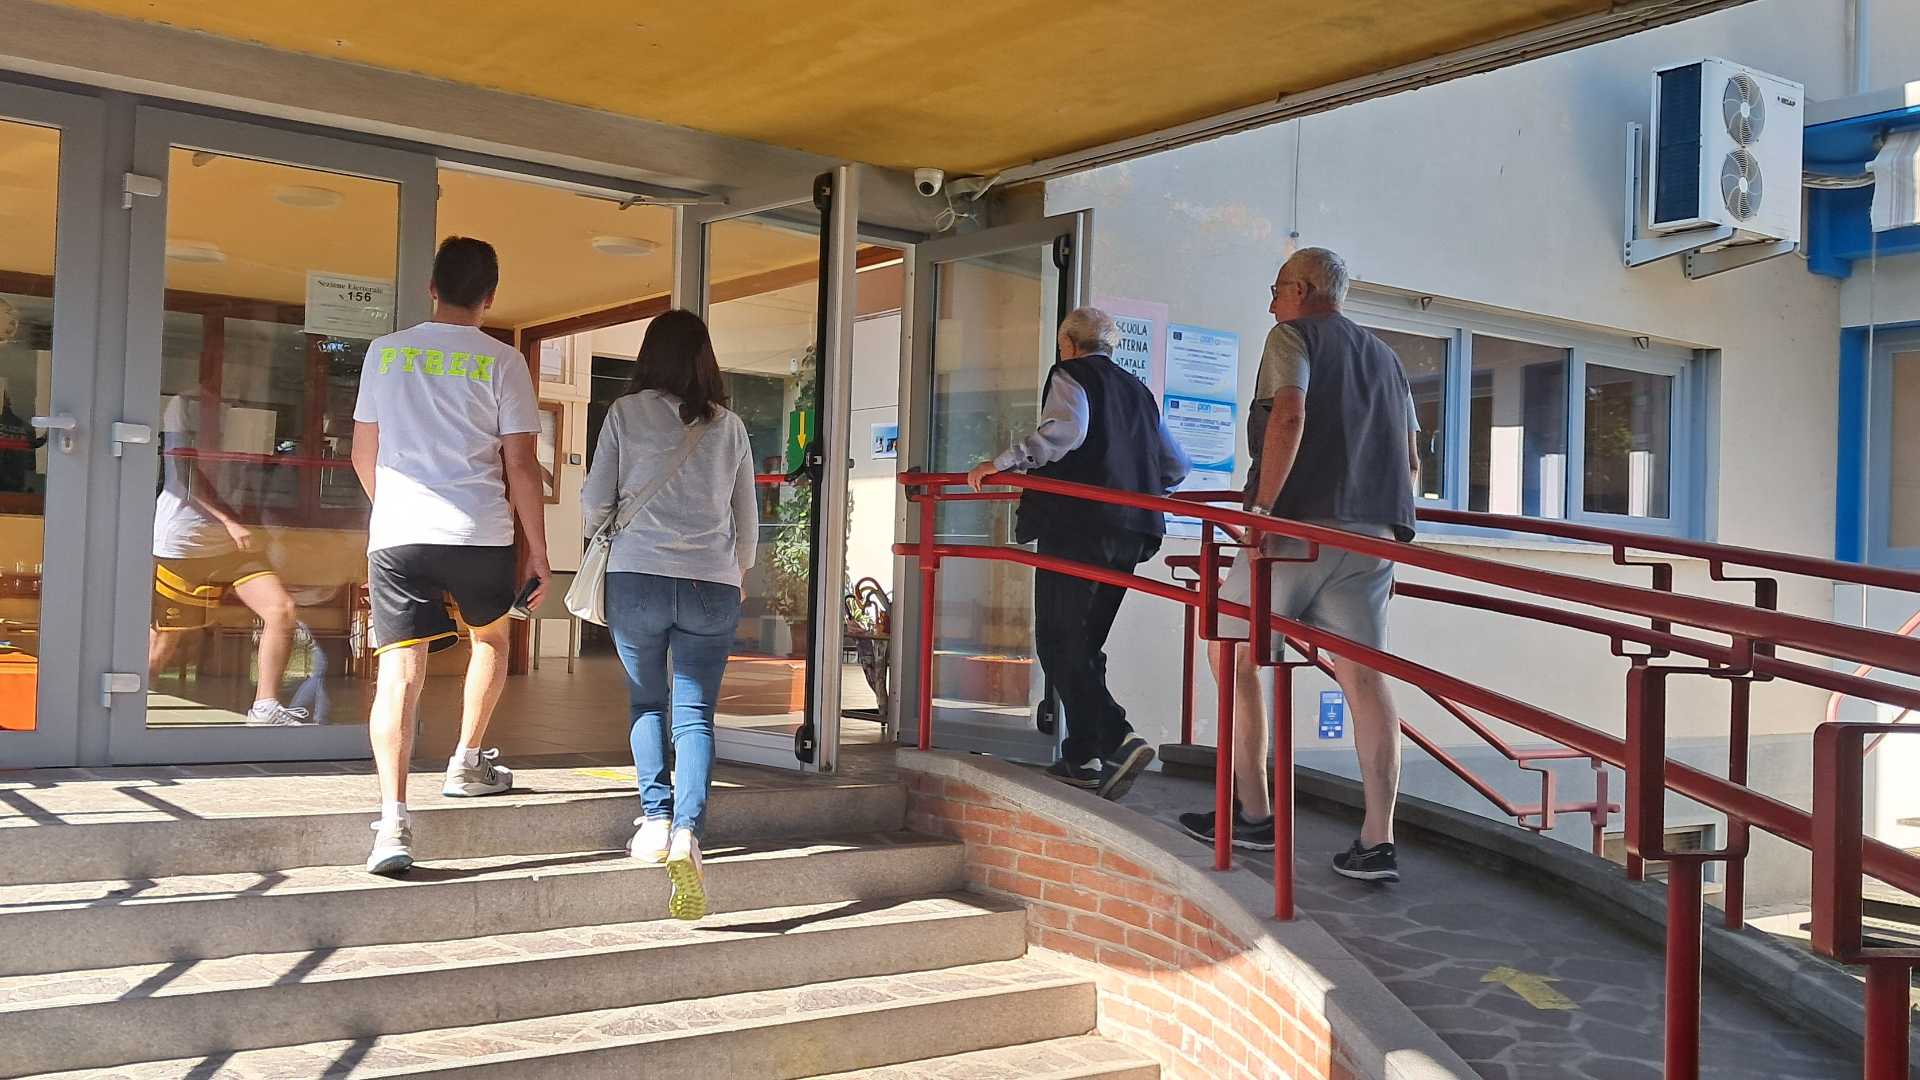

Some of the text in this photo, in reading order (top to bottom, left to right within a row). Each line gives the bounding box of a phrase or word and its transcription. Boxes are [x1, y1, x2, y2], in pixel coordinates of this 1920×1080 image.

[348, 291, 372, 302] 156
[1115, 320, 1148, 336] SCUOLA
[1115, 337, 1149, 352] ATERNA
[378, 346, 496, 382] PYREX
[1115, 357, 1146, 369] STATALE
